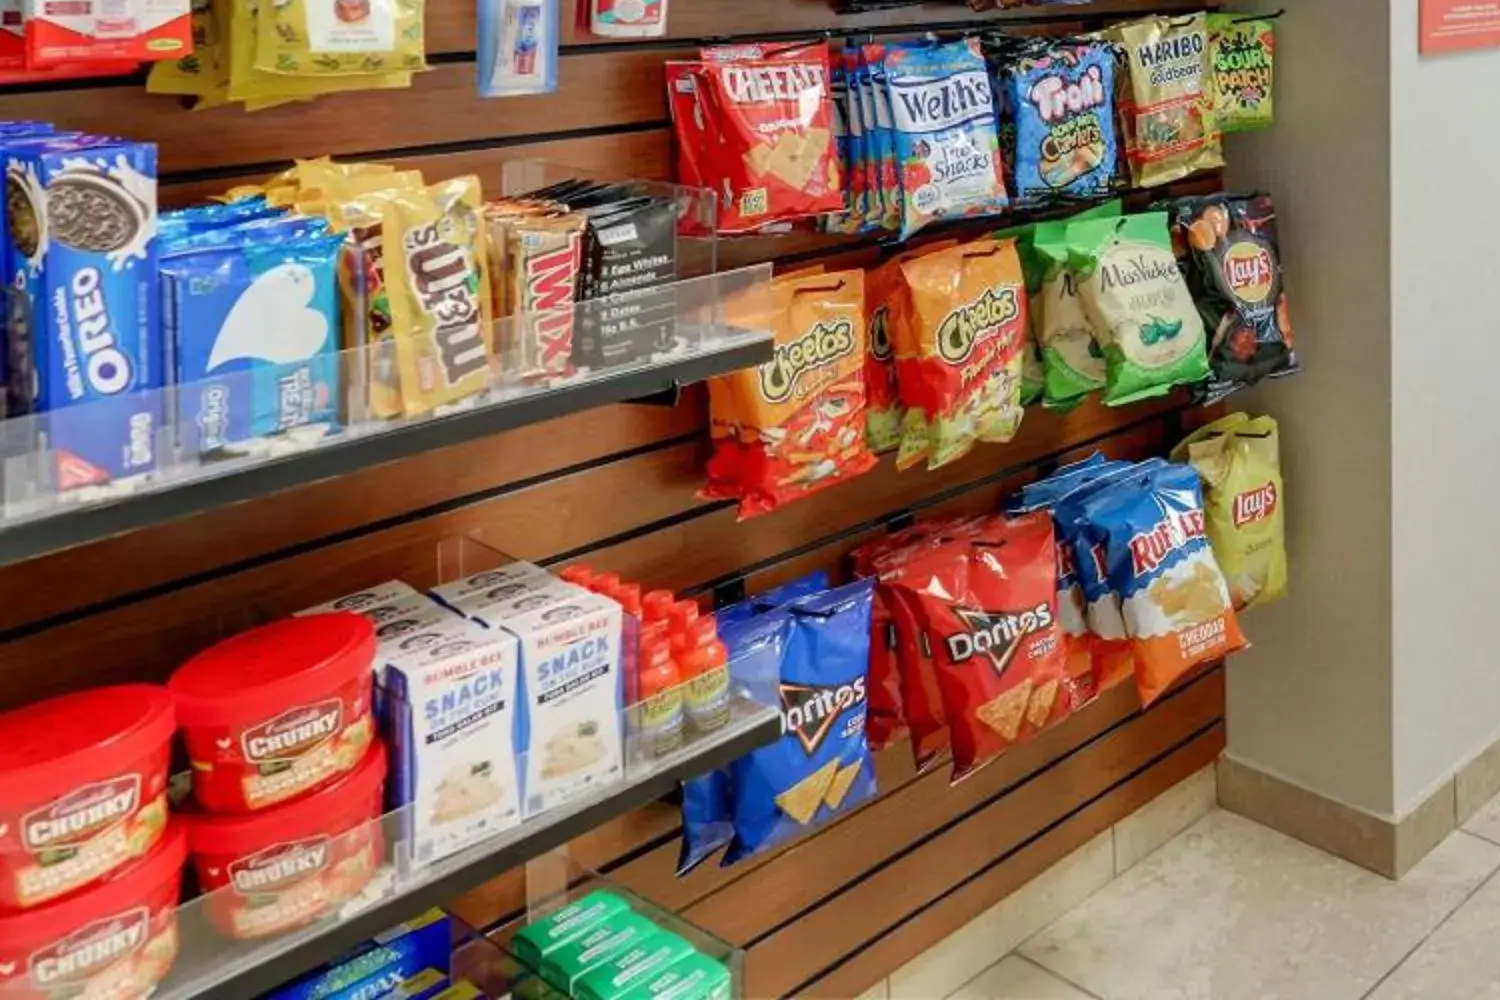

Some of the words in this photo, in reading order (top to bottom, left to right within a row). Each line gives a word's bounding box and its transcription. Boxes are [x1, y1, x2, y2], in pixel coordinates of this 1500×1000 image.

[1137, 34, 1203, 68] HARIBO
[1215, 48, 1265, 71] SOUR
[898, 77, 991, 124] Welch's
[1216, 67, 1270, 91] PATCH
[934, 153, 989, 181] Snacks
[1226, 247, 1272, 288] Lay's
[528, 233, 581, 377] TWIX
[937, 287, 1018, 365] Cheetos
[73, 267, 132, 394] OREO
[760, 320, 853, 400] Cheetos
[948, 602, 1051, 661] Doritos
[538, 634, 610, 681] SNACK
[425, 668, 504, 720] SNACK
[249, 709, 338, 757] CHUNKY
[28, 789, 136, 844] CHUNKY
[234, 842, 328, 887] CHUNKY
[34, 920, 144, 985] CHUNKY
